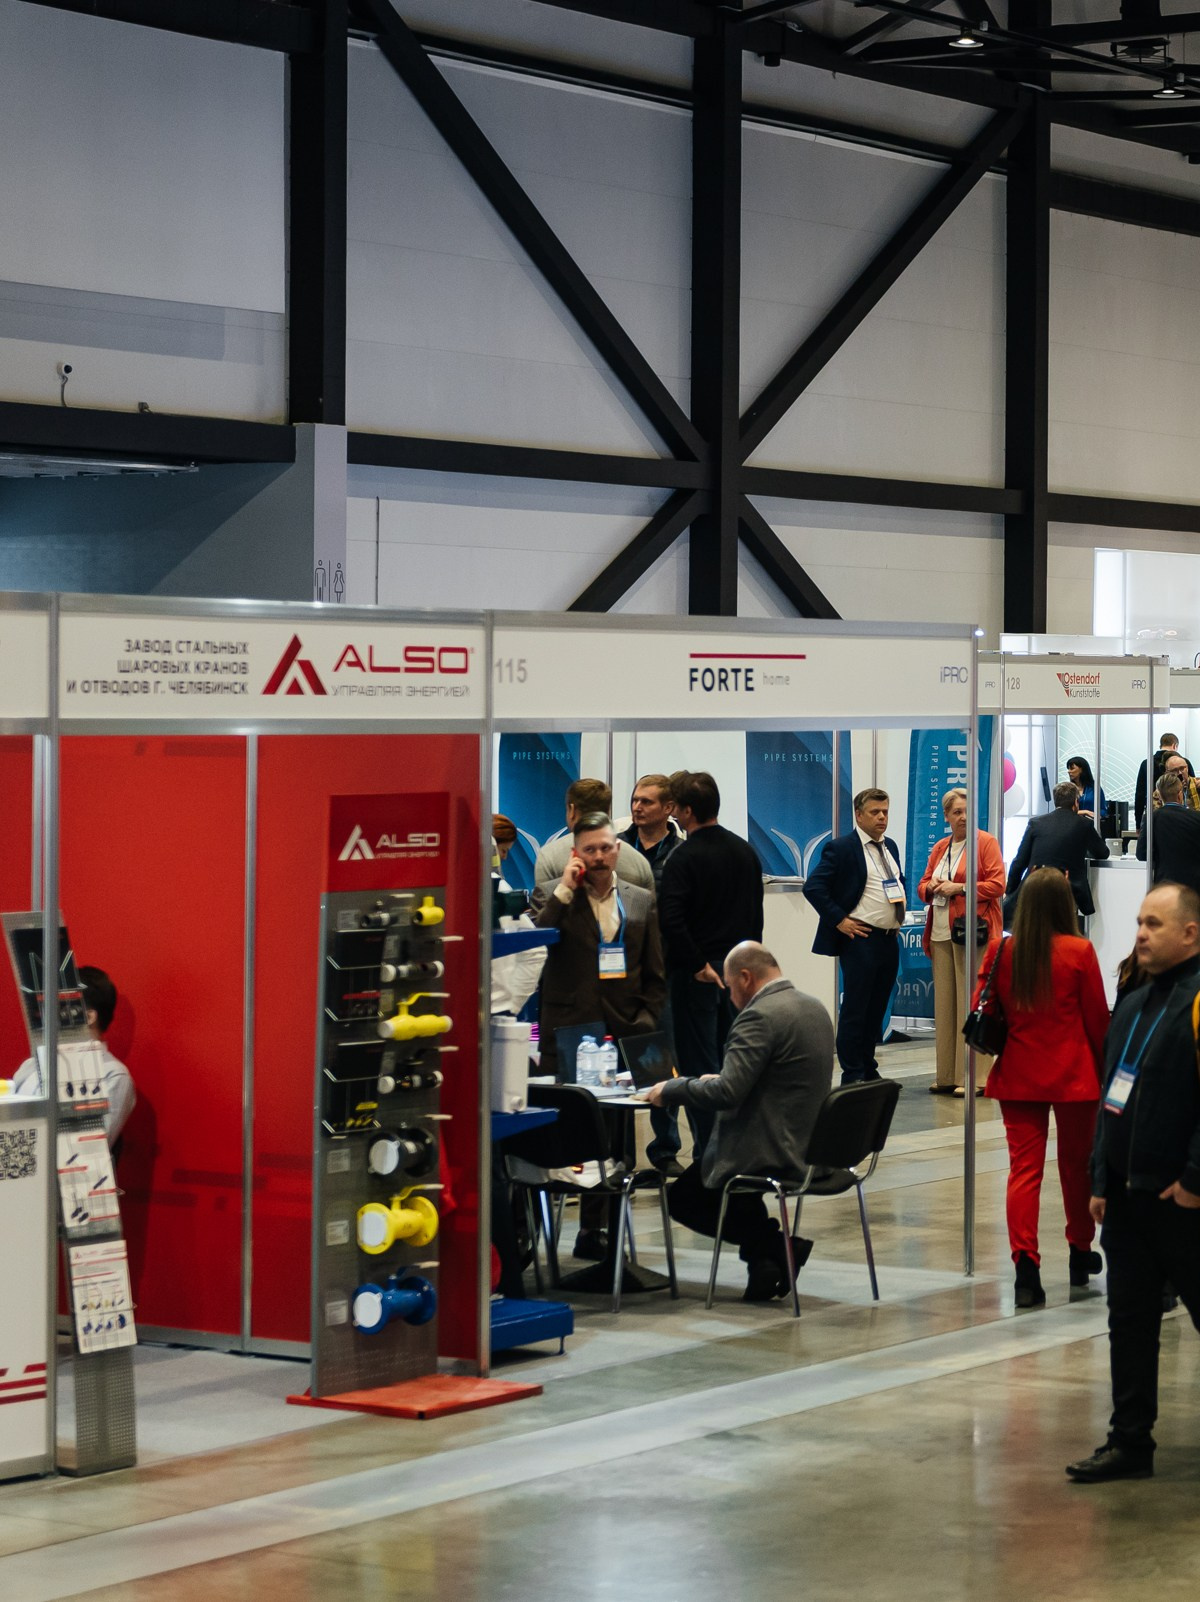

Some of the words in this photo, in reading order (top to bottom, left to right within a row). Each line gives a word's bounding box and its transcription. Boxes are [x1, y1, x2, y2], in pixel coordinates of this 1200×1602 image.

[124, 639, 172, 654] ЗАВОД
[175, 640, 249, 655] СТАЛЬНЫХ
[332, 643, 469, 674] ALSO
[117, 660, 191, 674] ШАРОВЫХ
[194, 661, 249, 675] КРАНОВ
[494, 658, 528, 683] 115
[689, 667, 754, 692] FORTE
[762, 672, 790, 685] home
[1006, 677, 1020, 690] 128
[1063, 672, 1100, 684] Ostendorf
[66, 680, 77, 693] И
[80, 680, 150, 696] ОТВОДОВ
[168, 681, 249, 694] ЧЕЛЯБИНСК
[1069, 688, 1100, 698] Kunststoffe
[512, 752, 531, 760] PIPE
[536, 752, 571, 760] SYSTEMS
[764, 754, 786, 762] PIPE
[792, 754, 833, 762] SYSTEMS
[931, 745, 939, 770] PIPE
[930, 778, 938, 827] SYSTEMS
[375, 833, 440, 848] ALSO
[910, 934, 923, 948] PR
